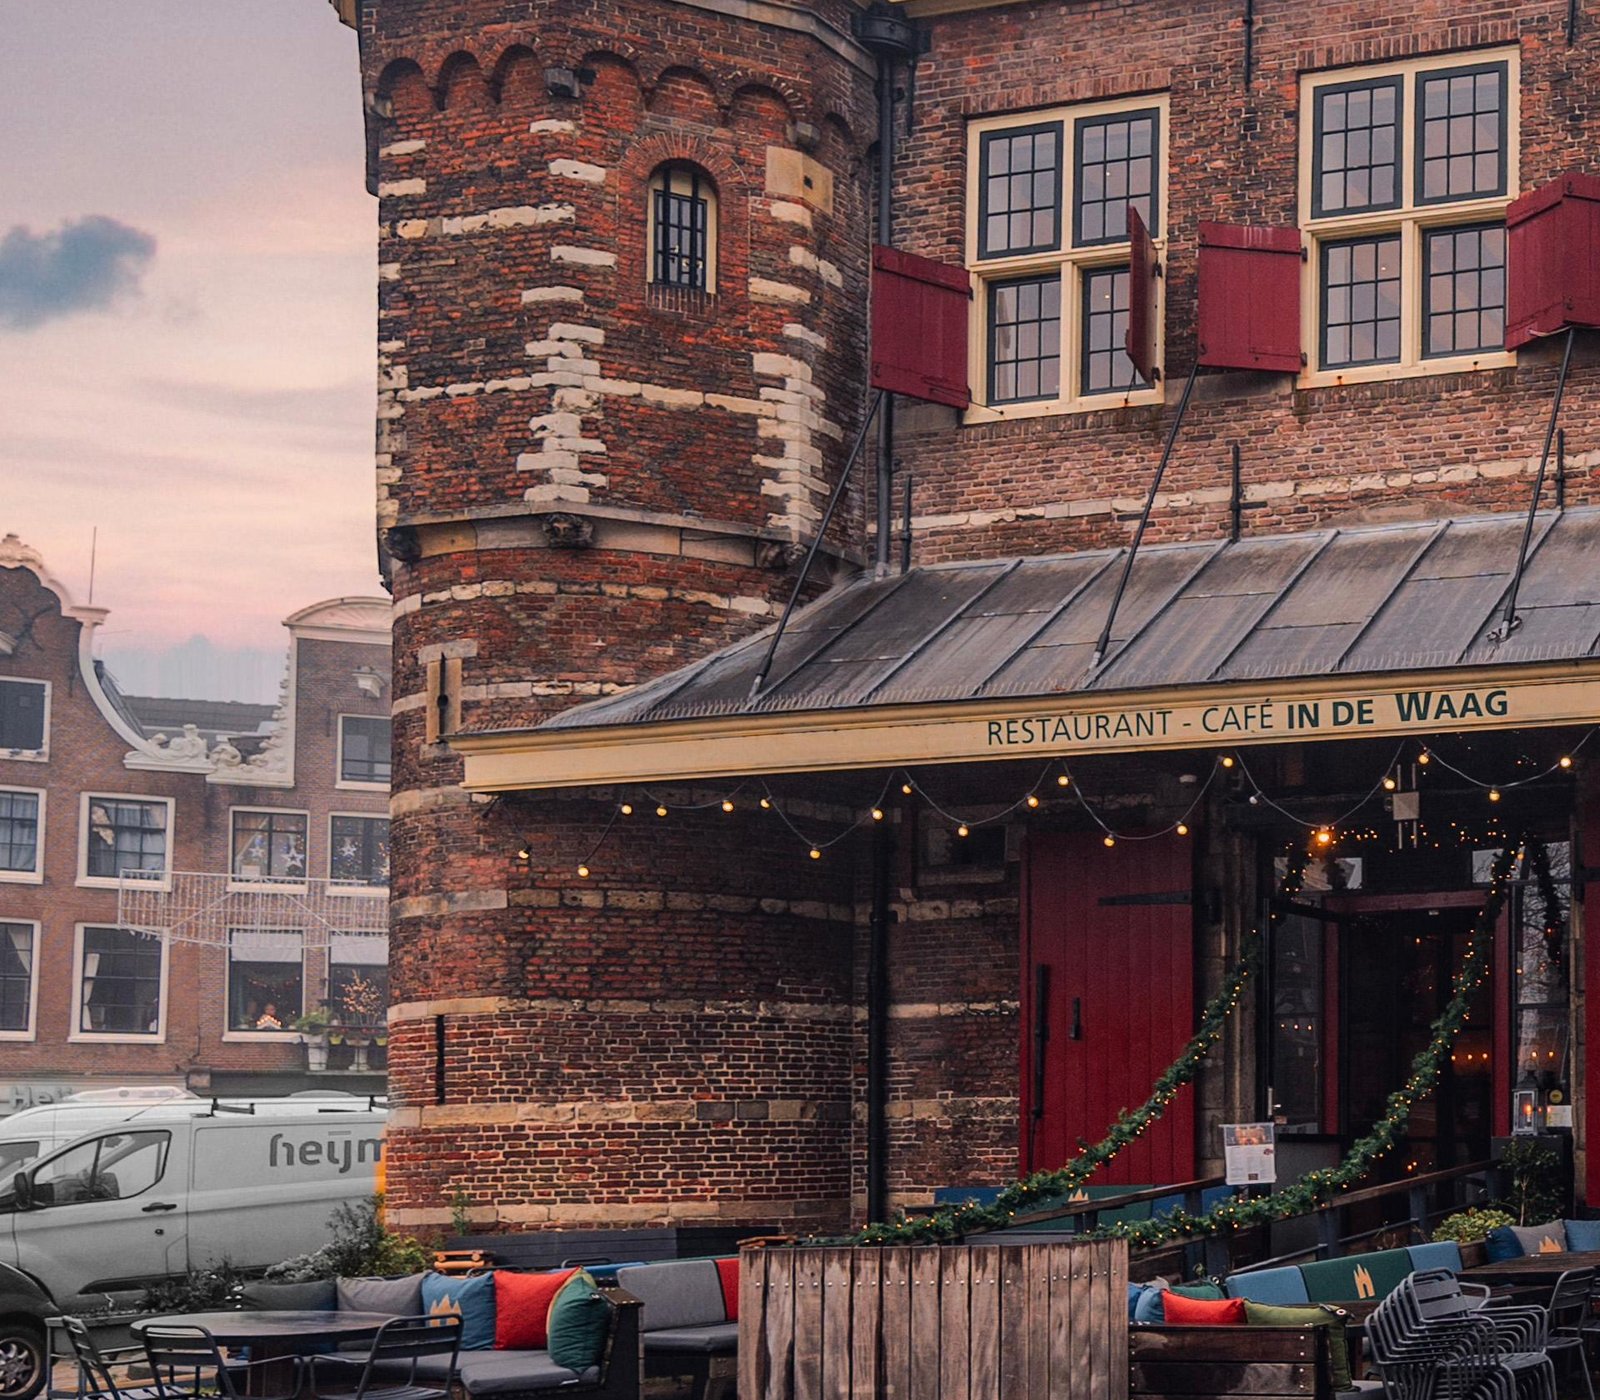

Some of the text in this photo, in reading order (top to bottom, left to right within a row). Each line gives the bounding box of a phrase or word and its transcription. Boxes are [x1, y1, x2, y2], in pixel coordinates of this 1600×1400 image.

[987, 710, 1173, 746] RESTAURANT
[1201, 698, 1273, 733] CAFÉ
[1287, 702, 1319, 730] IN
[1332, 699, 1374, 727] DE
[1395, 690, 1508, 723] WAAG
